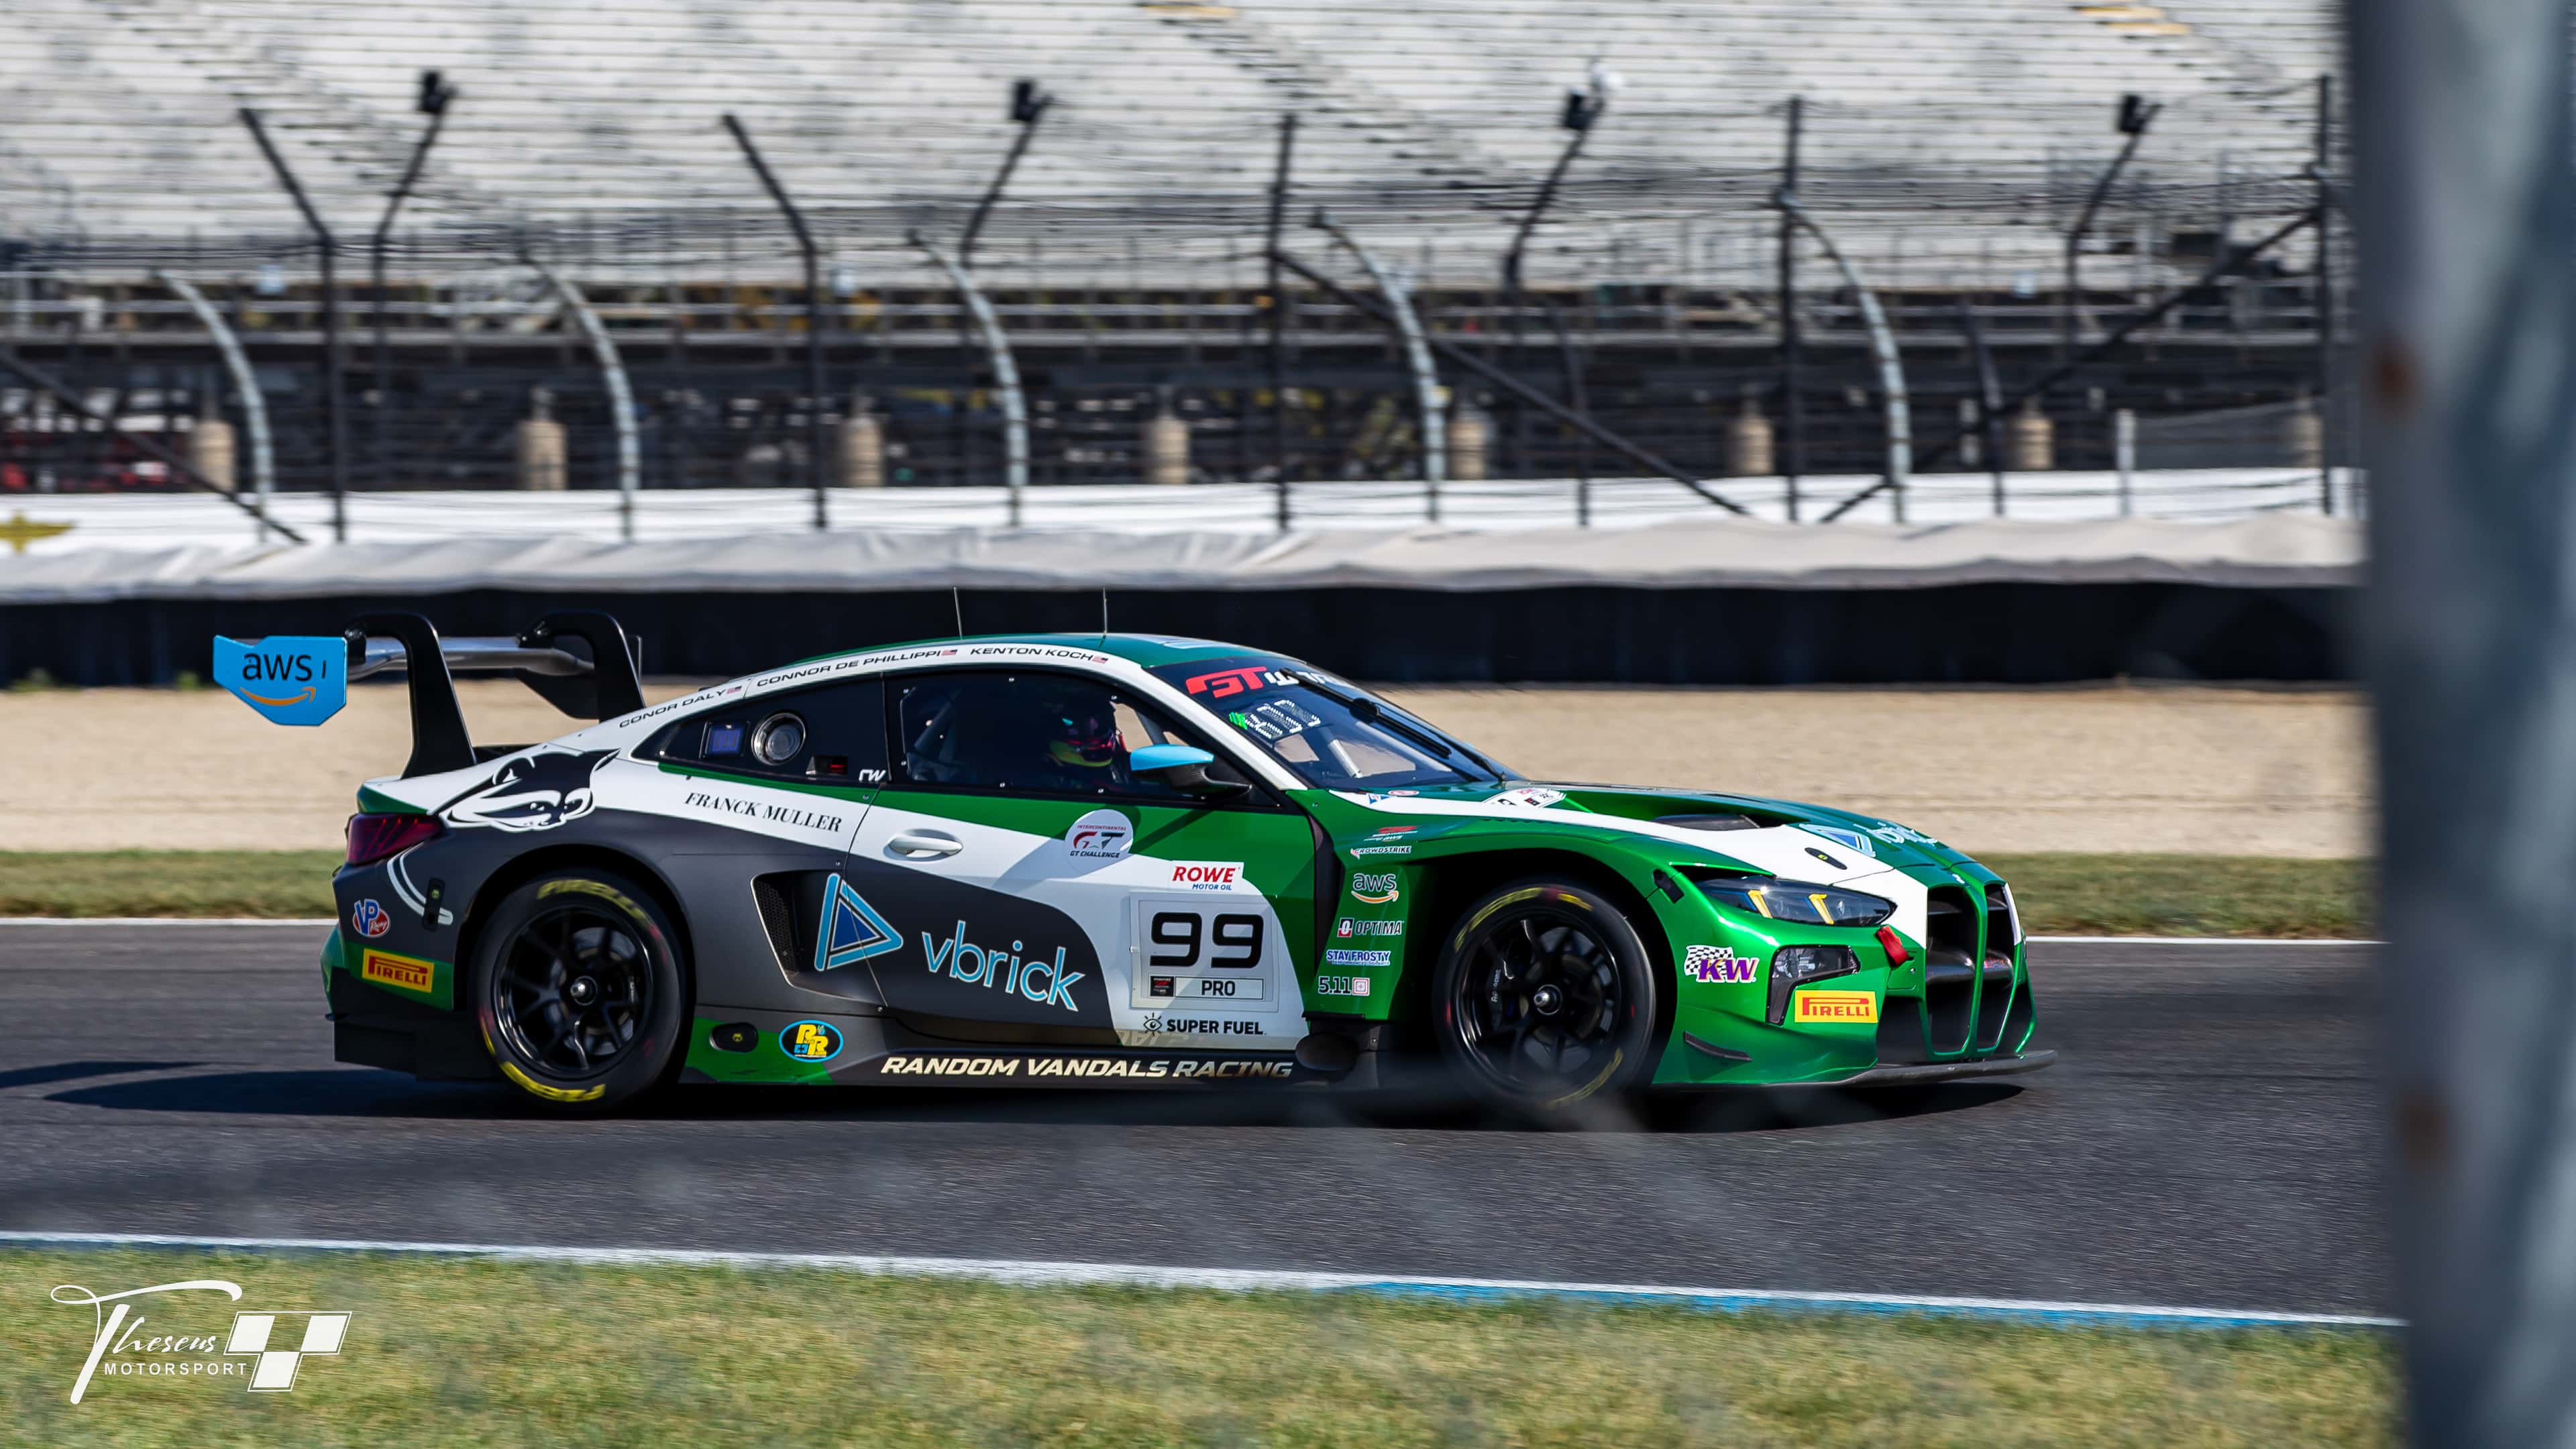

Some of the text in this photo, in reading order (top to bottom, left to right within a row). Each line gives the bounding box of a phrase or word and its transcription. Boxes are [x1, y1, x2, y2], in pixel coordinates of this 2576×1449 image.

[970, 647, 1093, 661] KENTON KOCH
[242, 653, 312, 682] aws
[757, 649, 941, 687] CONNOR DE PHILLIPPI
[1185, 666, 1267, 698] GT
[619, 689, 727, 728] CONOR DALY
[685, 792, 842, 832] FRANCK MULLER
[1172, 865, 1235, 883] ROWE
[1353, 873, 1397, 891] aws
[1355, 921, 1402, 935] OPTIMA
[1150, 912, 1264, 969] 99
[922, 919, 1086, 1012] vbrick
[1327, 950, 1390, 961] STAY FROSTY
[368, 955, 428, 986] PIRELLI
[1201, 980, 1236, 996] PRO
[1318, 976, 1350, 994] 5.11
[1802, 997, 1870, 1016] PIRELLI
[1167, 1019, 1264, 1035] SUPER FUEL
[881, 1057, 1294, 1078] RANDOM VANDALS RACING
